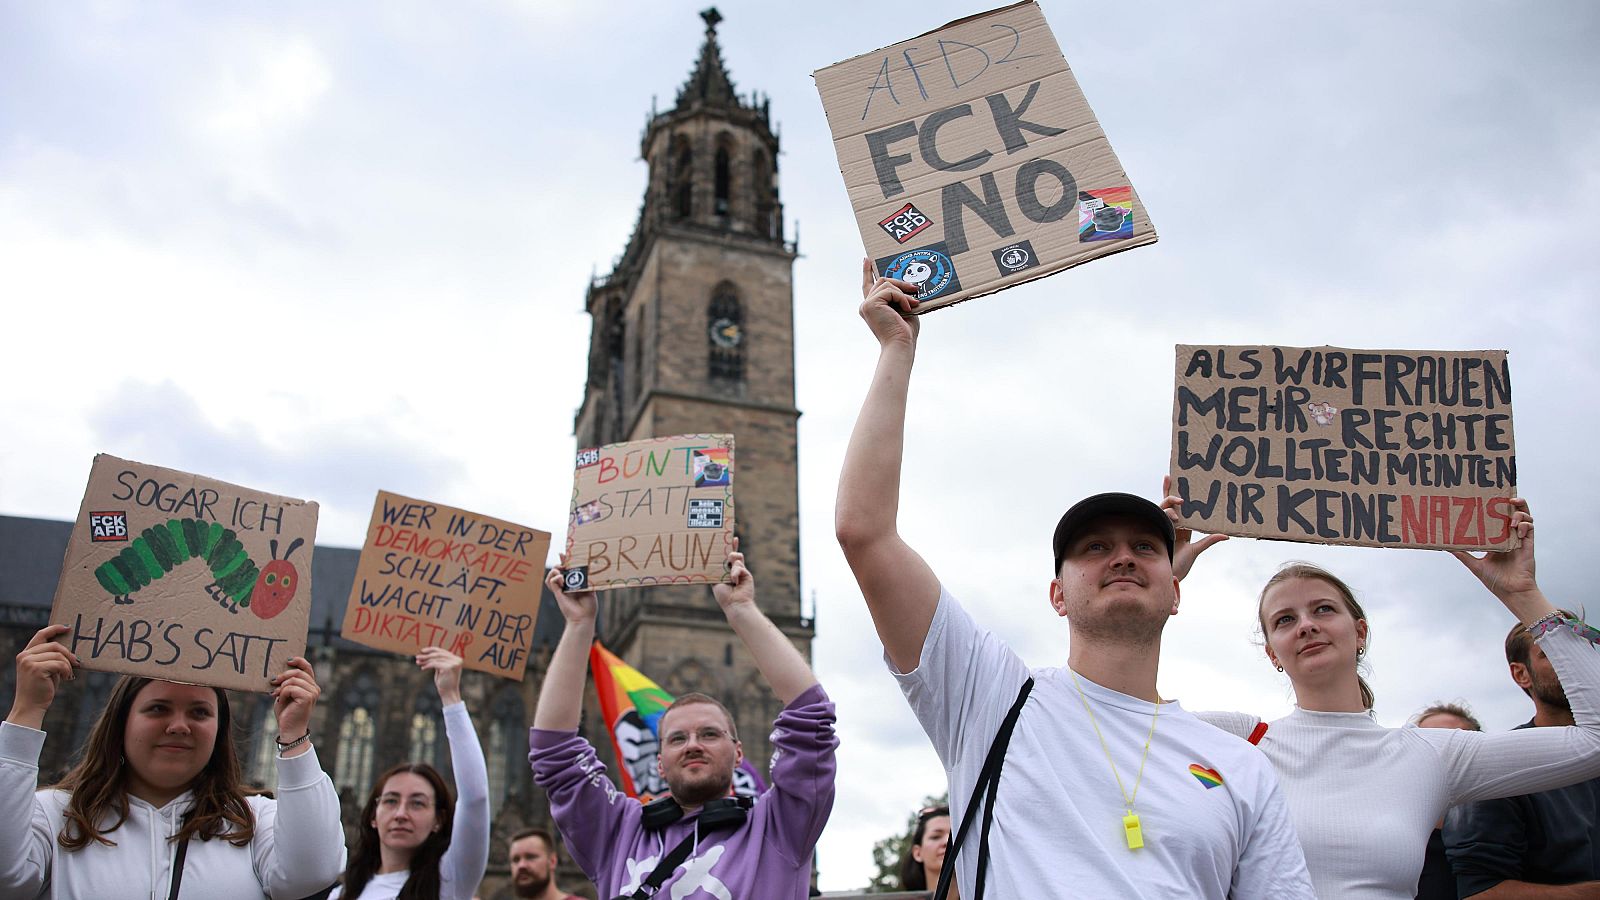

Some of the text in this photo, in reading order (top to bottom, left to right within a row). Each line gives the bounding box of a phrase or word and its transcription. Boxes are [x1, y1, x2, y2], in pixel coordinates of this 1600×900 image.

[864, 82, 1067, 199] FCK
[884, 208, 920, 233] FCK
[895, 215, 926, 239] AFD
[941, 159, 1078, 256] NO
[1185, 348, 1512, 408] ALS WIR FRAUEN
[1178, 386, 1510, 451] MEHR RECHTE
[598, 446, 708, 483] BUNT
[1178, 431, 1516, 488] WOLLTEN MEINTEN
[92, 516, 125, 526] FCK
[112, 470, 283, 534] SOGAR ICH
[382, 500, 533, 556] WER IN DER
[594, 486, 696, 522] STATT
[1178, 477, 1512, 546] WIR KEINE NAZIS
[94, 526, 126, 536] AFD
[374, 524, 532, 582] DEMOKRATIE
[588, 532, 716, 576] BRAUN
[379, 553, 506, 604] SCHLÄFT,
[352, 607, 526, 670] DIKTATUR AUF
[360, 580, 532, 646] WACHT IN DER
[71, 614, 288, 678] HAB'S SATT
